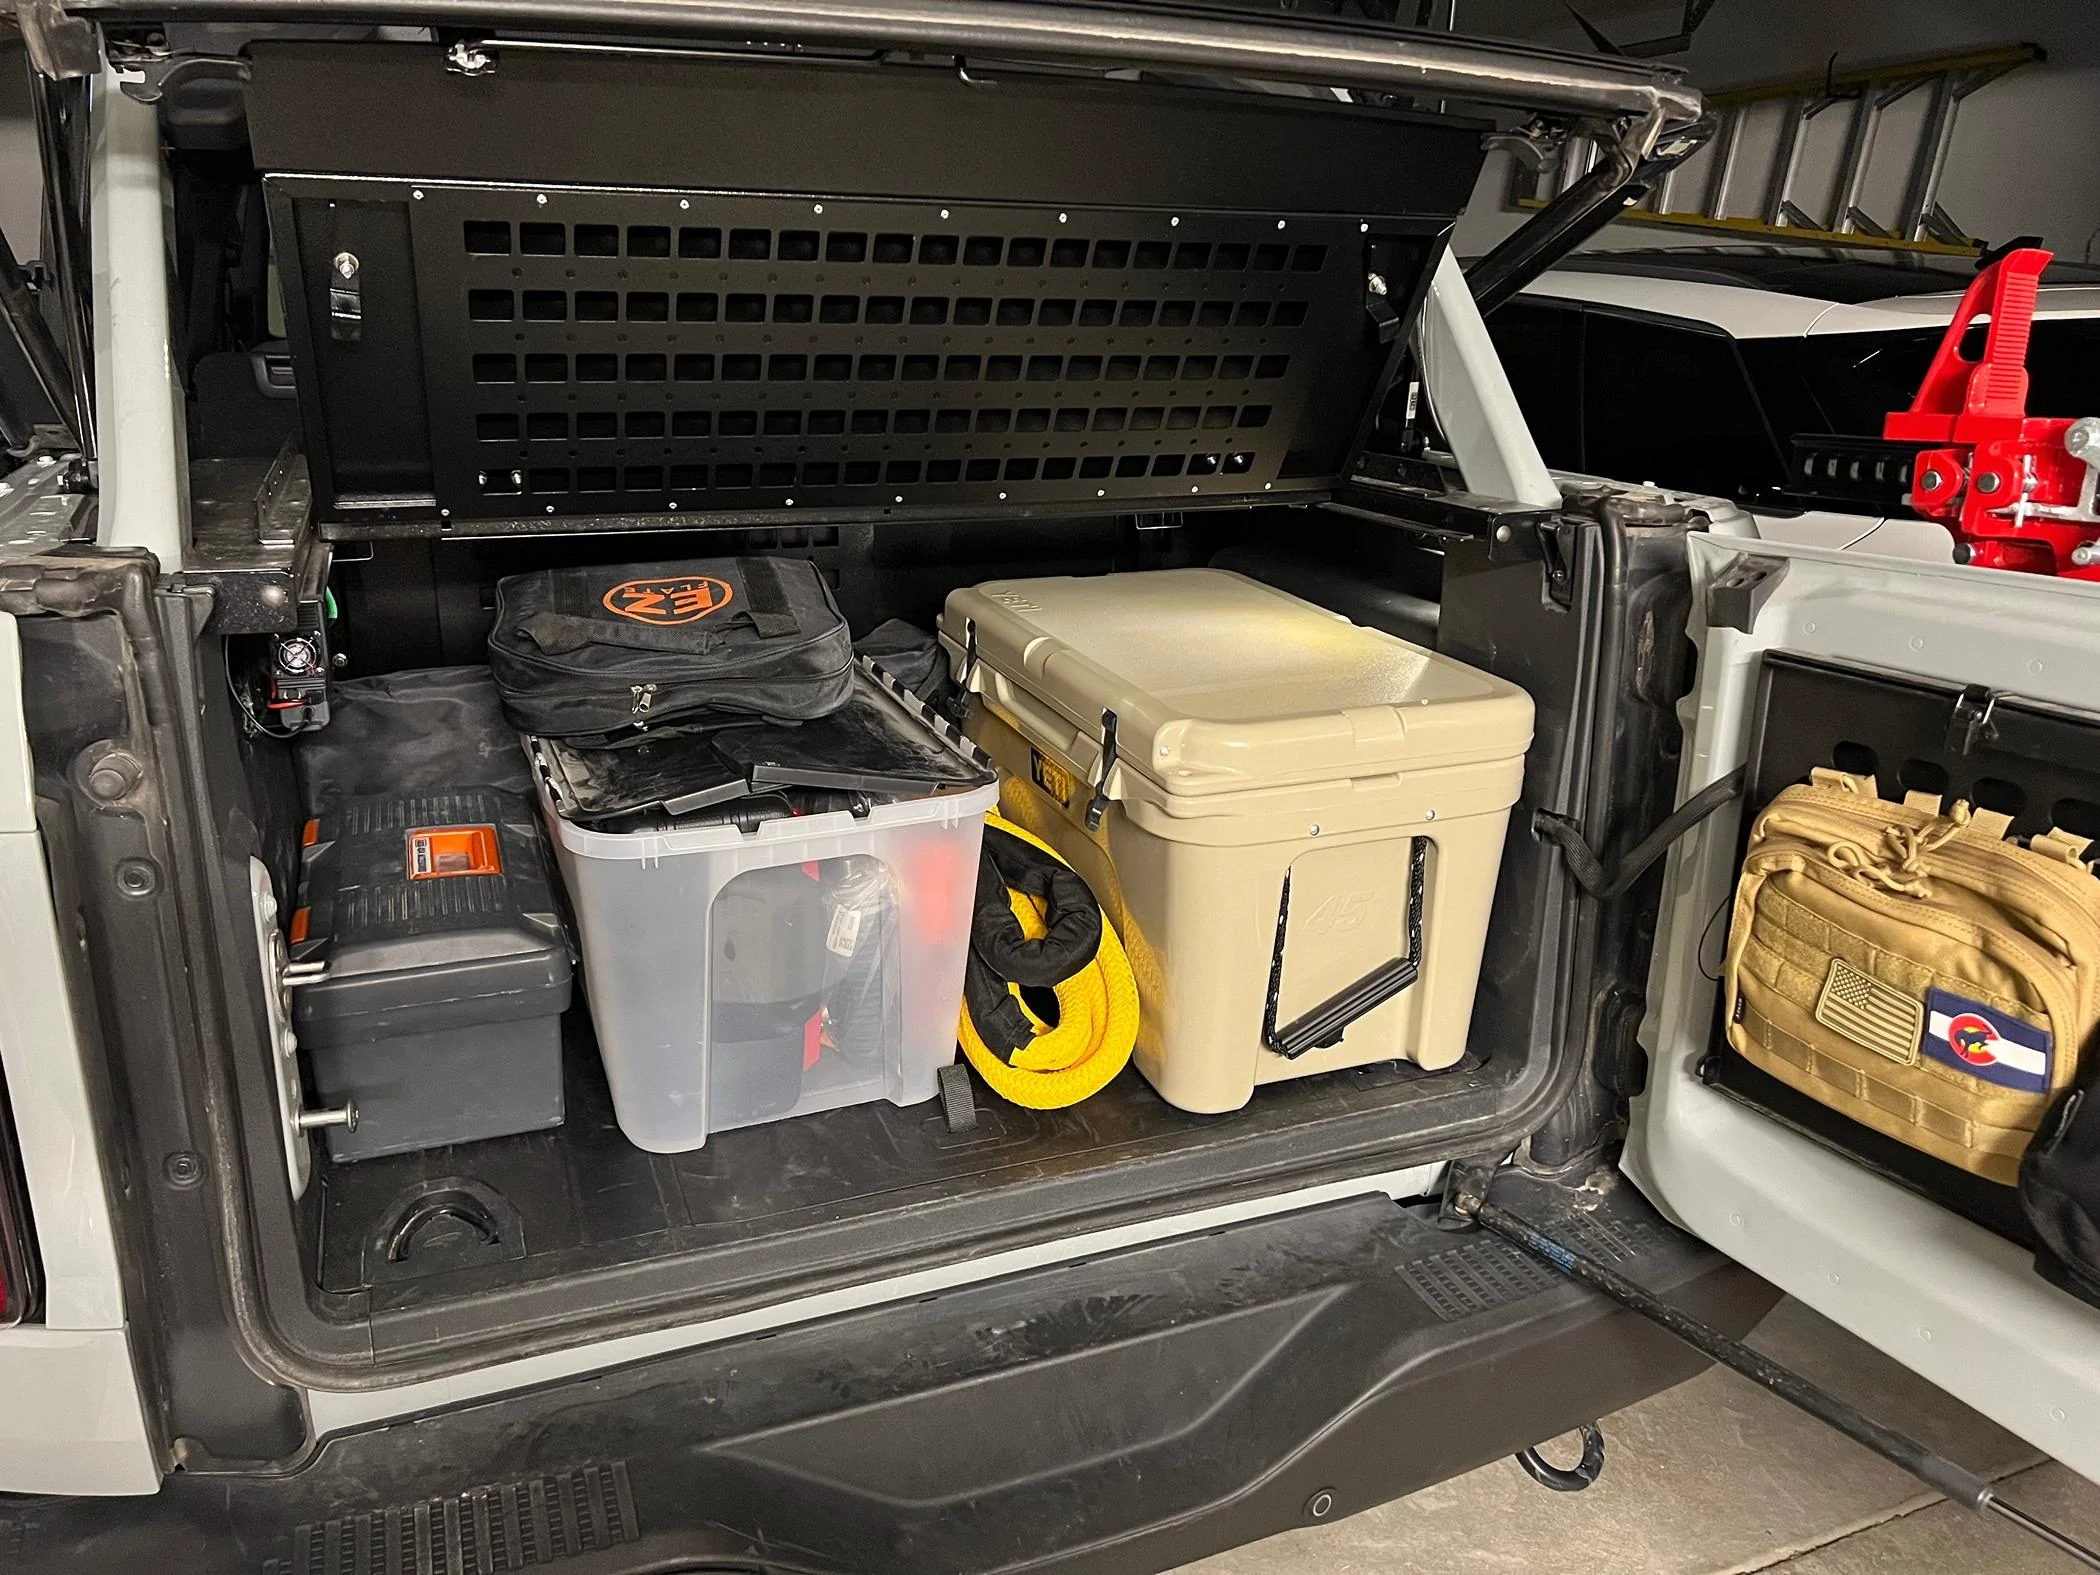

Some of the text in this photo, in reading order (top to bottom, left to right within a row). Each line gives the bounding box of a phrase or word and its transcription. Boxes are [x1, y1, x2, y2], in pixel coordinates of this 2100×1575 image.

[622, 587, 713, 615] EZ
[991, 590, 1043, 613] YETI
[1032, 752, 1067, 803] YETI
[1301, 889, 1376, 936] 45
